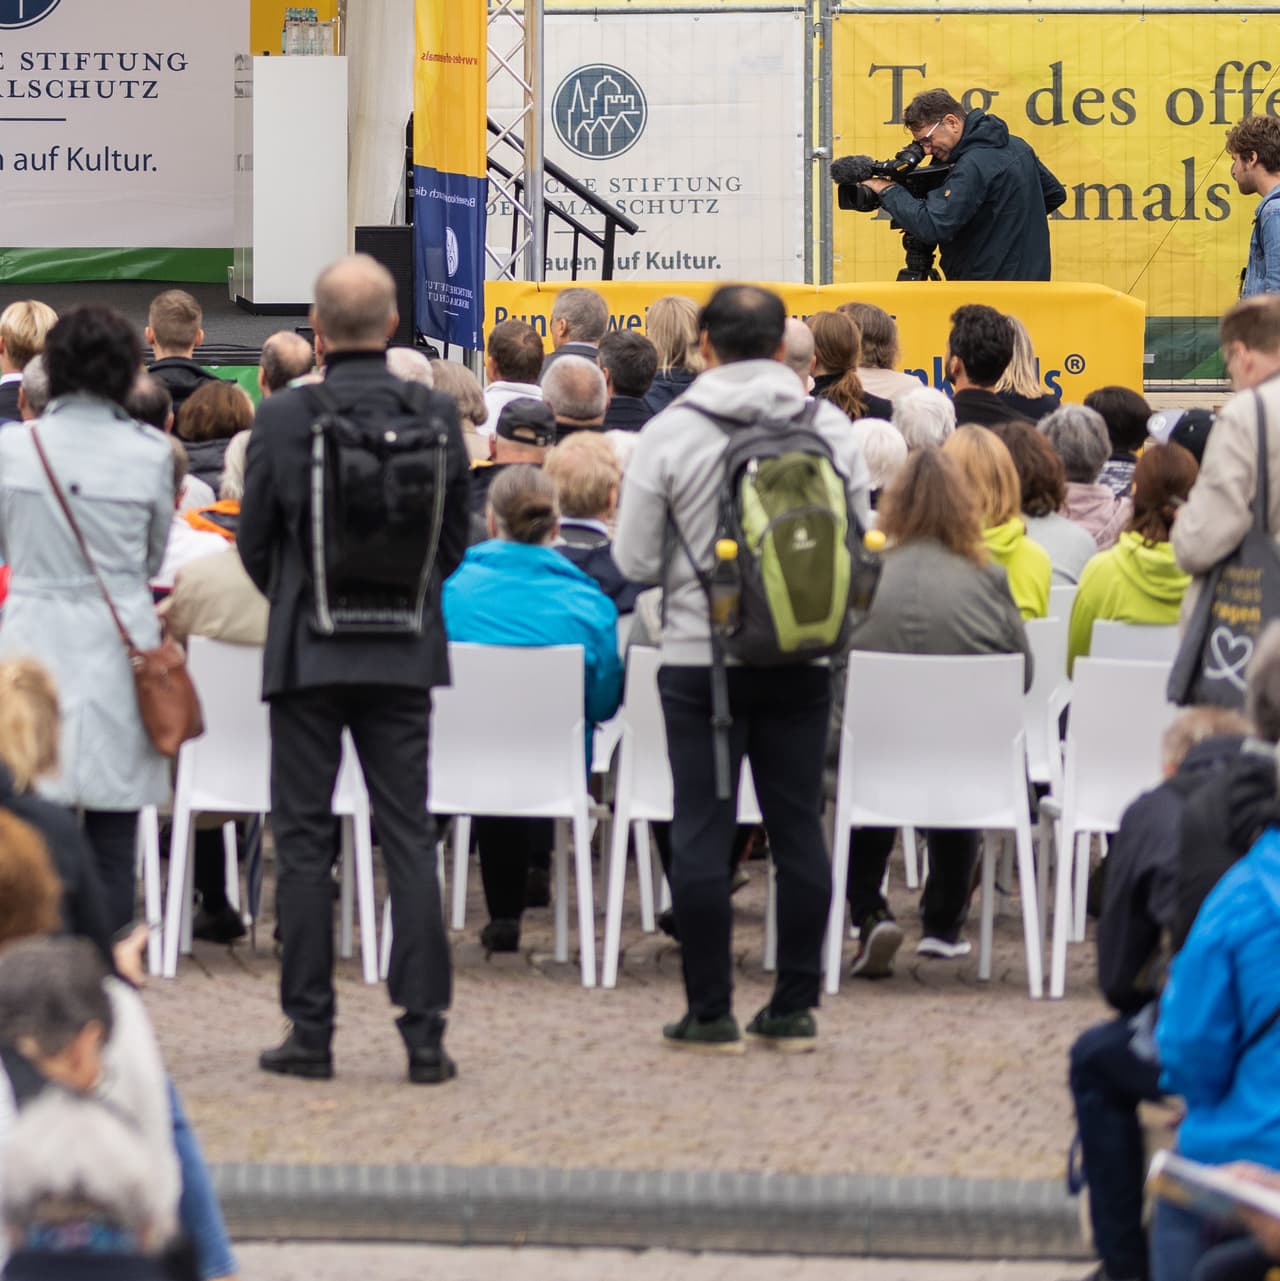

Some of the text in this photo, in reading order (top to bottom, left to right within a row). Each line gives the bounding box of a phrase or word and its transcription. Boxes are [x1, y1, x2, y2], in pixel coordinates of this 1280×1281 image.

[20, 51, 189, 72] STIFTUNG
[1026, 60, 1137, 127] des
[13, 145, 59, 172] auf
[66, 146, 158, 173] Kultur.
[609, 176, 743, 193] STIFTUNG
[1052, 156, 1233, 221] mals
[544, 251, 722, 271] auen uf Kultur.
